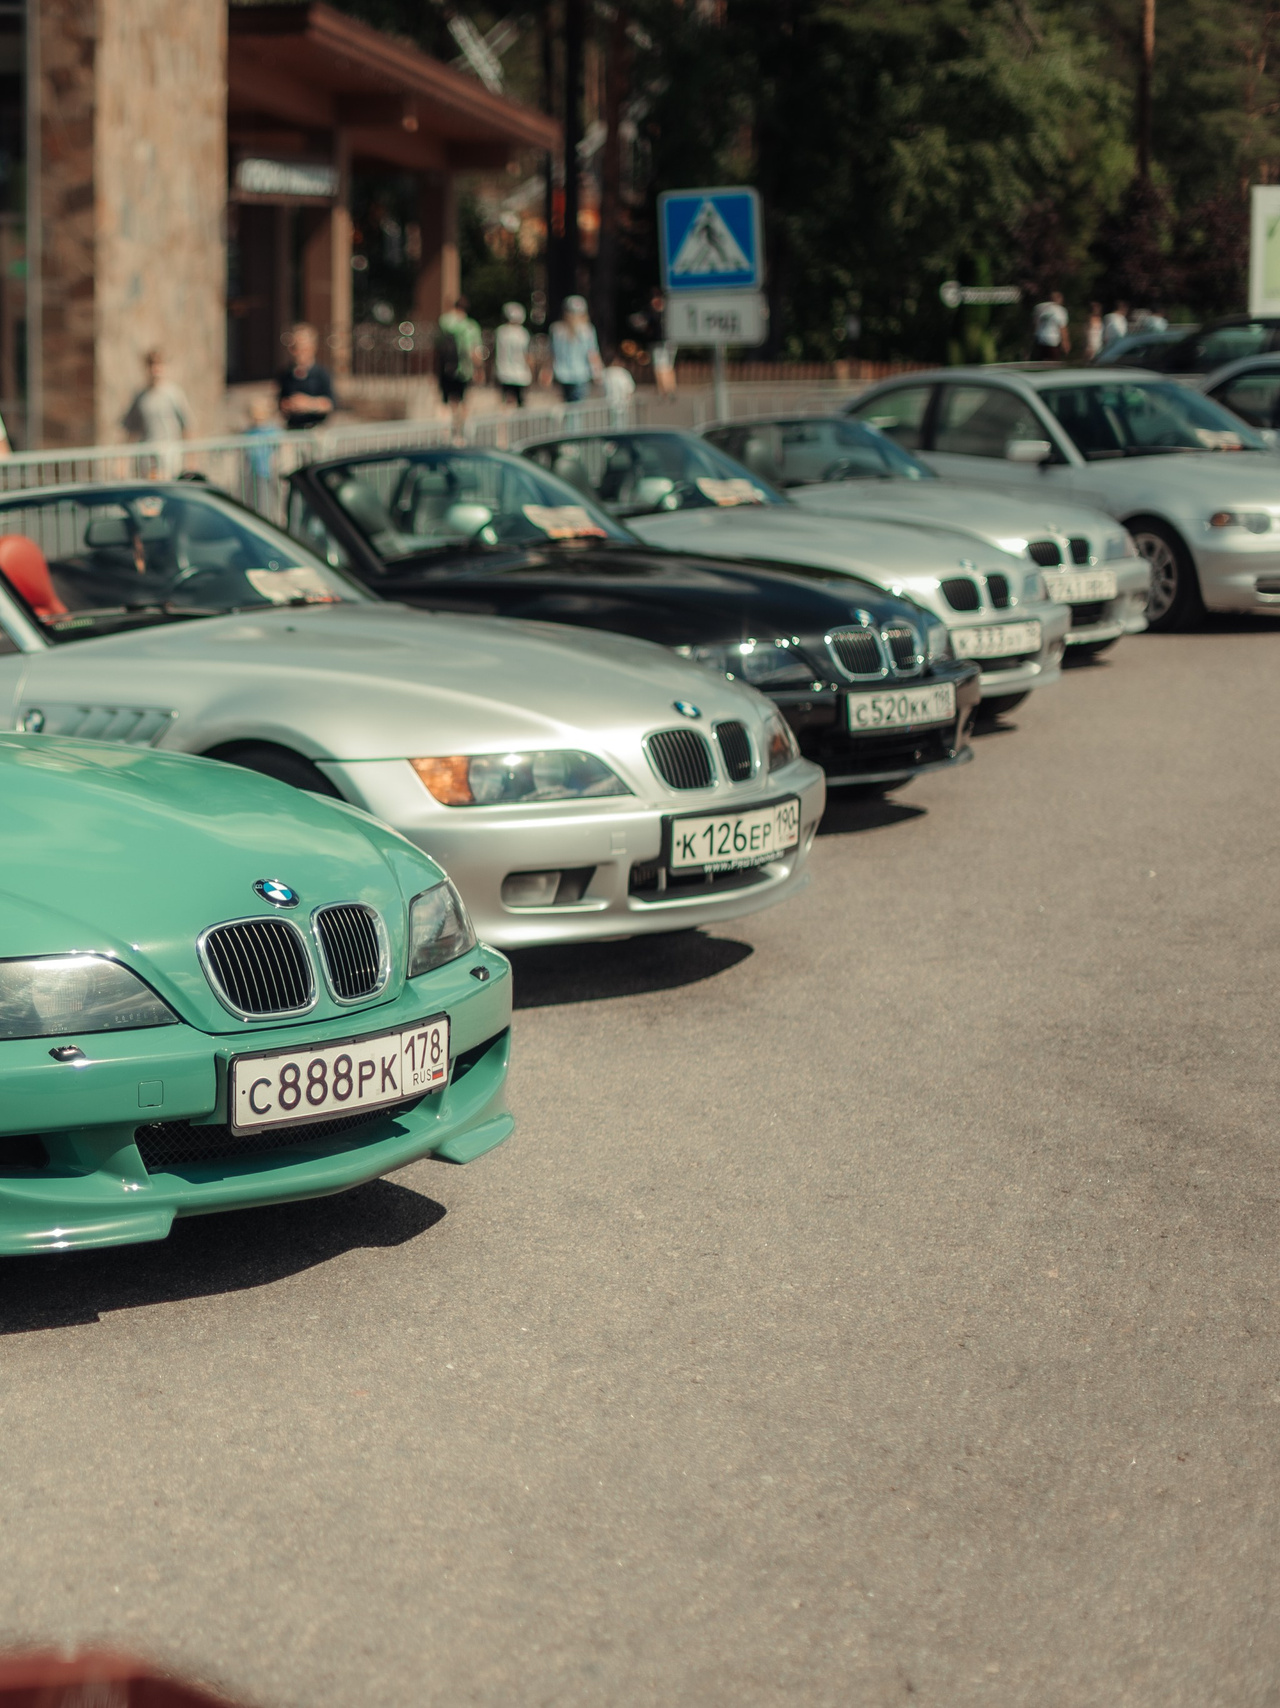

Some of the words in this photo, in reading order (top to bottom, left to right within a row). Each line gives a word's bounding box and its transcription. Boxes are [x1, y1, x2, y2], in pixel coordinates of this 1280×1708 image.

[856, 694, 930, 726] С520КК
[682, 819, 771, 860] К126ЕР
[776, 805, 796, 834] 190
[249, 1053, 398, 1114] С888РК
[404, 1028, 440, 1071] 178
[412, 1068, 432, 1085] RUS
